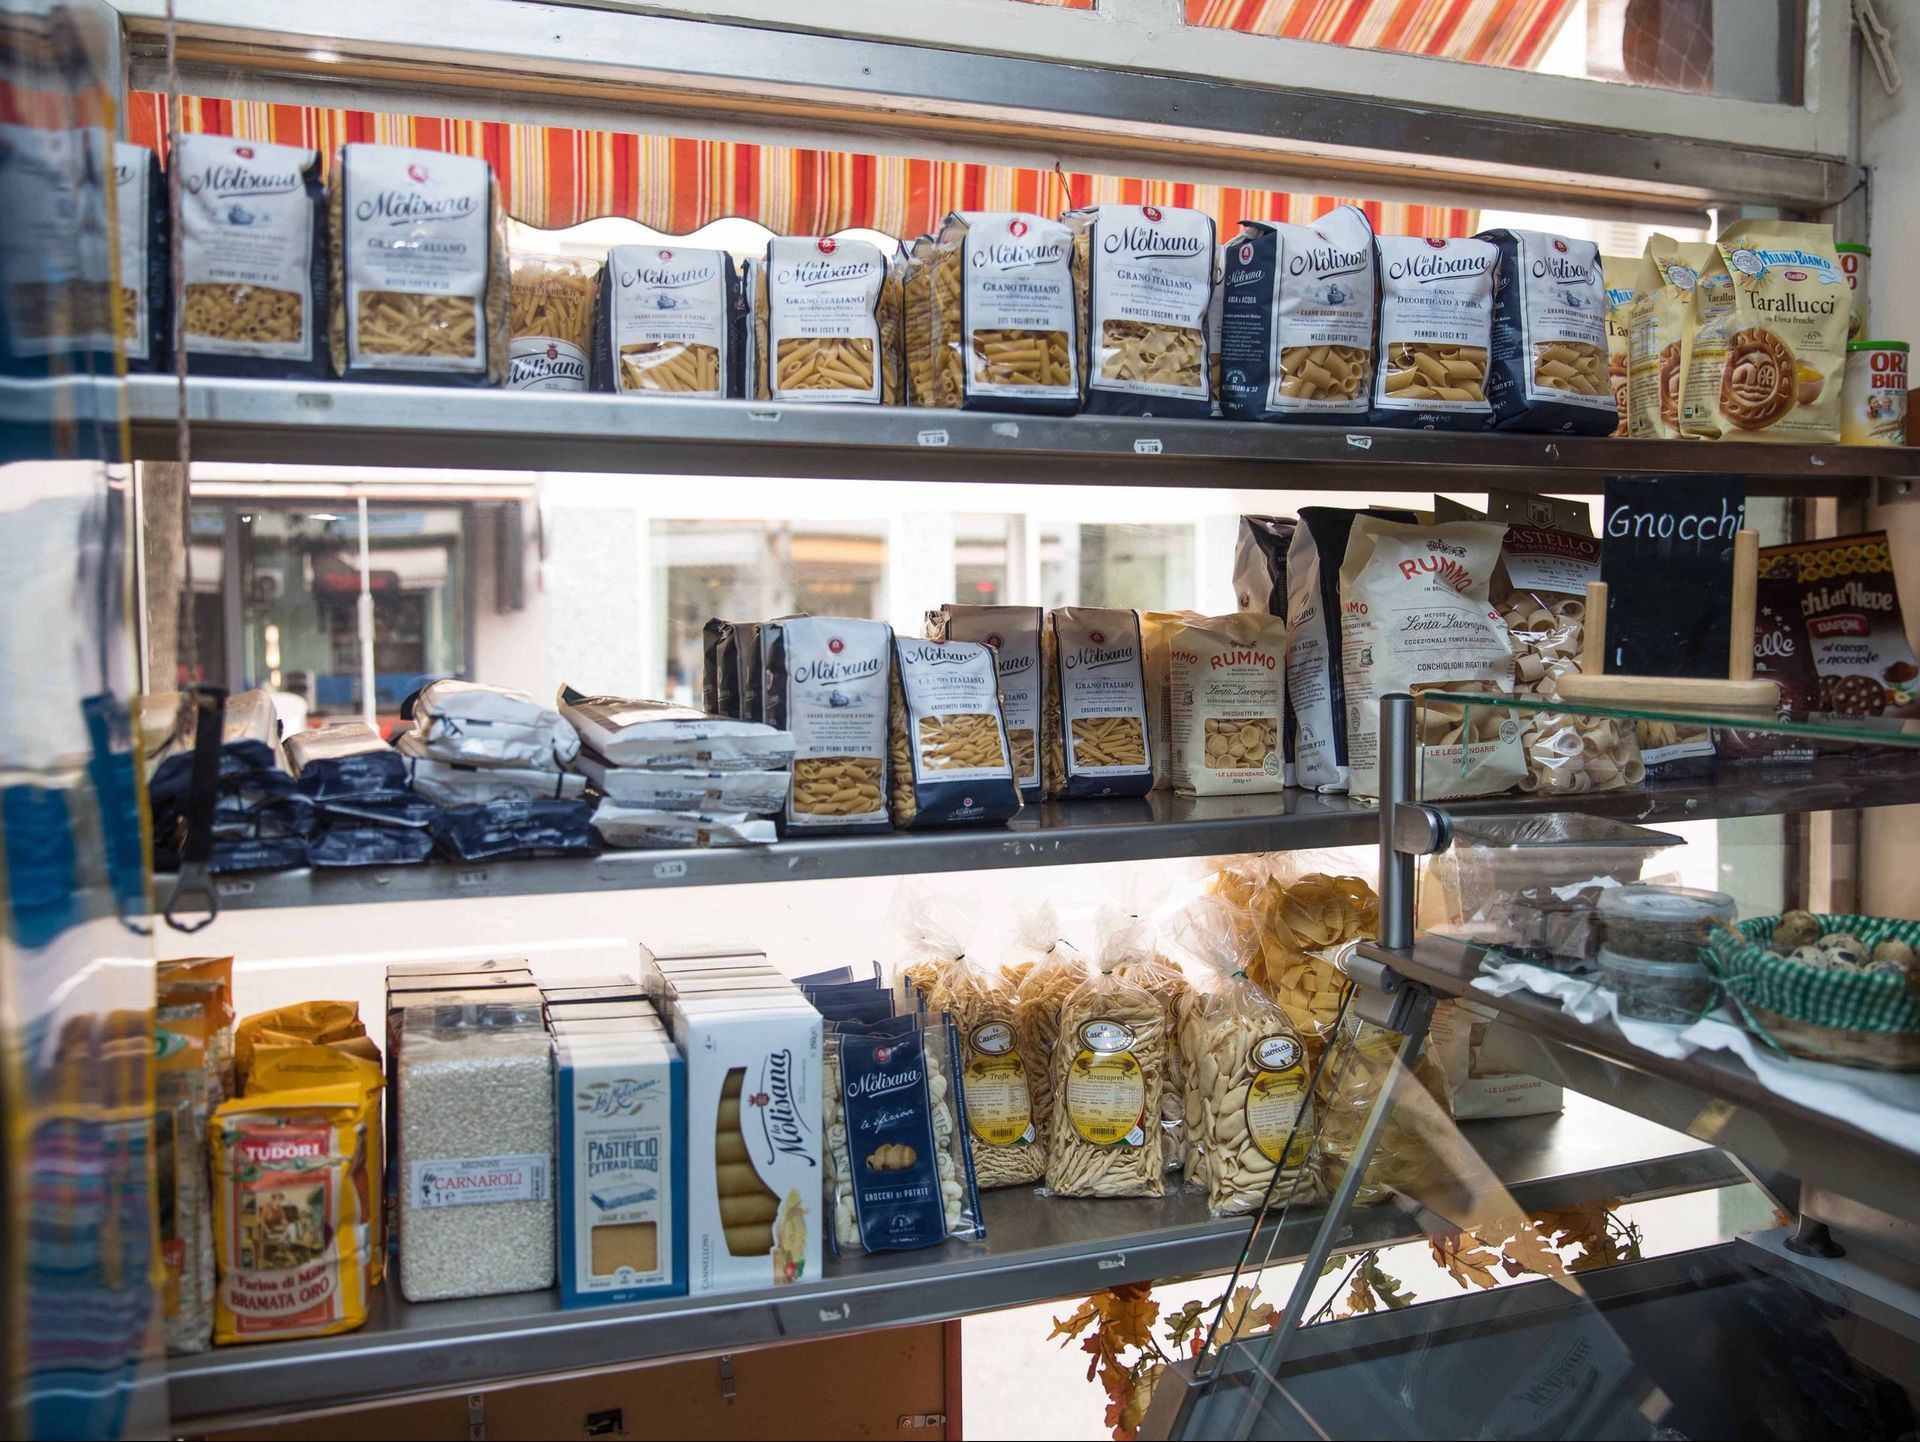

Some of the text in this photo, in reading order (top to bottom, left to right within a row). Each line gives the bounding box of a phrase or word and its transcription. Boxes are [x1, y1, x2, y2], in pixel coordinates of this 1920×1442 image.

[188, 165, 301, 197] Molisana
[356, 191, 478, 225] Molisana
[1104, 226, 1204, 258] Molisana
[973, 245, 1064, 271] Molisana
[1290, 248, 1368, 279] Molisana
[621, 267, 715, 289] Molisana
[778, 261, 875, 288] Molisana
[1390, 255, 1490, 283] Molisana
[983, 282, 1060, 294] GRANO ITALIANO
[1117, 269, 1192, 291] GRANO ITALIANO
[1397, 296, 1452, 306] DECORTICATO
[1745, 290, 1835, 314] Tarallucci
[1774, 315, 1815, 324] Uova fresche
[1607, 498, 1745, 540] Gnocchi
[1398, 555, 1473, 593] RUMMO
[1831, 581, 1893, 612] di Neve
[1400, 615, 1442, 632] Lenta
[1404, 638, 1447, 646] ECCEZIONALE
[1754, 631, 1795, 657] elle
[1835, 643, 1869, 653] cacao
[906, 645, 983, 665] Molisana
[1065, 647, 1136, 670] Molisana
[1171, 651, 1198, 665] MMO
[1210, 650, 1276, 671] RUMMO
[1826, 651, 1880, 665] nocciole
[795, 659, 883, 685] Molisana
[1417, 661, 1481, 672] CONCHIGLIONI RIGATI
[950, 677, 985, 685] ITALIANO
[1076, 681, 1134, 690] GRANO ITALIANO
[1206, 684, 1233, 696] Lenta
[1004, 693, 1028, 701] LIANO
[1430, 745, 1496, 757] LE LEGGNDARIE
[1260, 1043, 1291, 1059] Casereccia
[848, 1069, 922, 1098] Molisana
[1498, 1081, 1543, 1093] LEGGENDARIE
[770, 1048, 817, 1168] Molisana
[246, 1144, 320, 1161] TUDORI
[588, 1137, 659, 1162] PASTIFICIO
[588, 1161, 620, 1178] EXTRA
[629, 1157, 659, 1173] LUSSO
[433, 1172, 523, 1190] CARNAROLI
[864, 1187, 929, 1202] GNOCCHI PATATE
[230, 1276, 329, 1311] BRAMATA ORO
[238, 1275, 279, 1291] Farina
[282, 1275, 295, 1289] di
